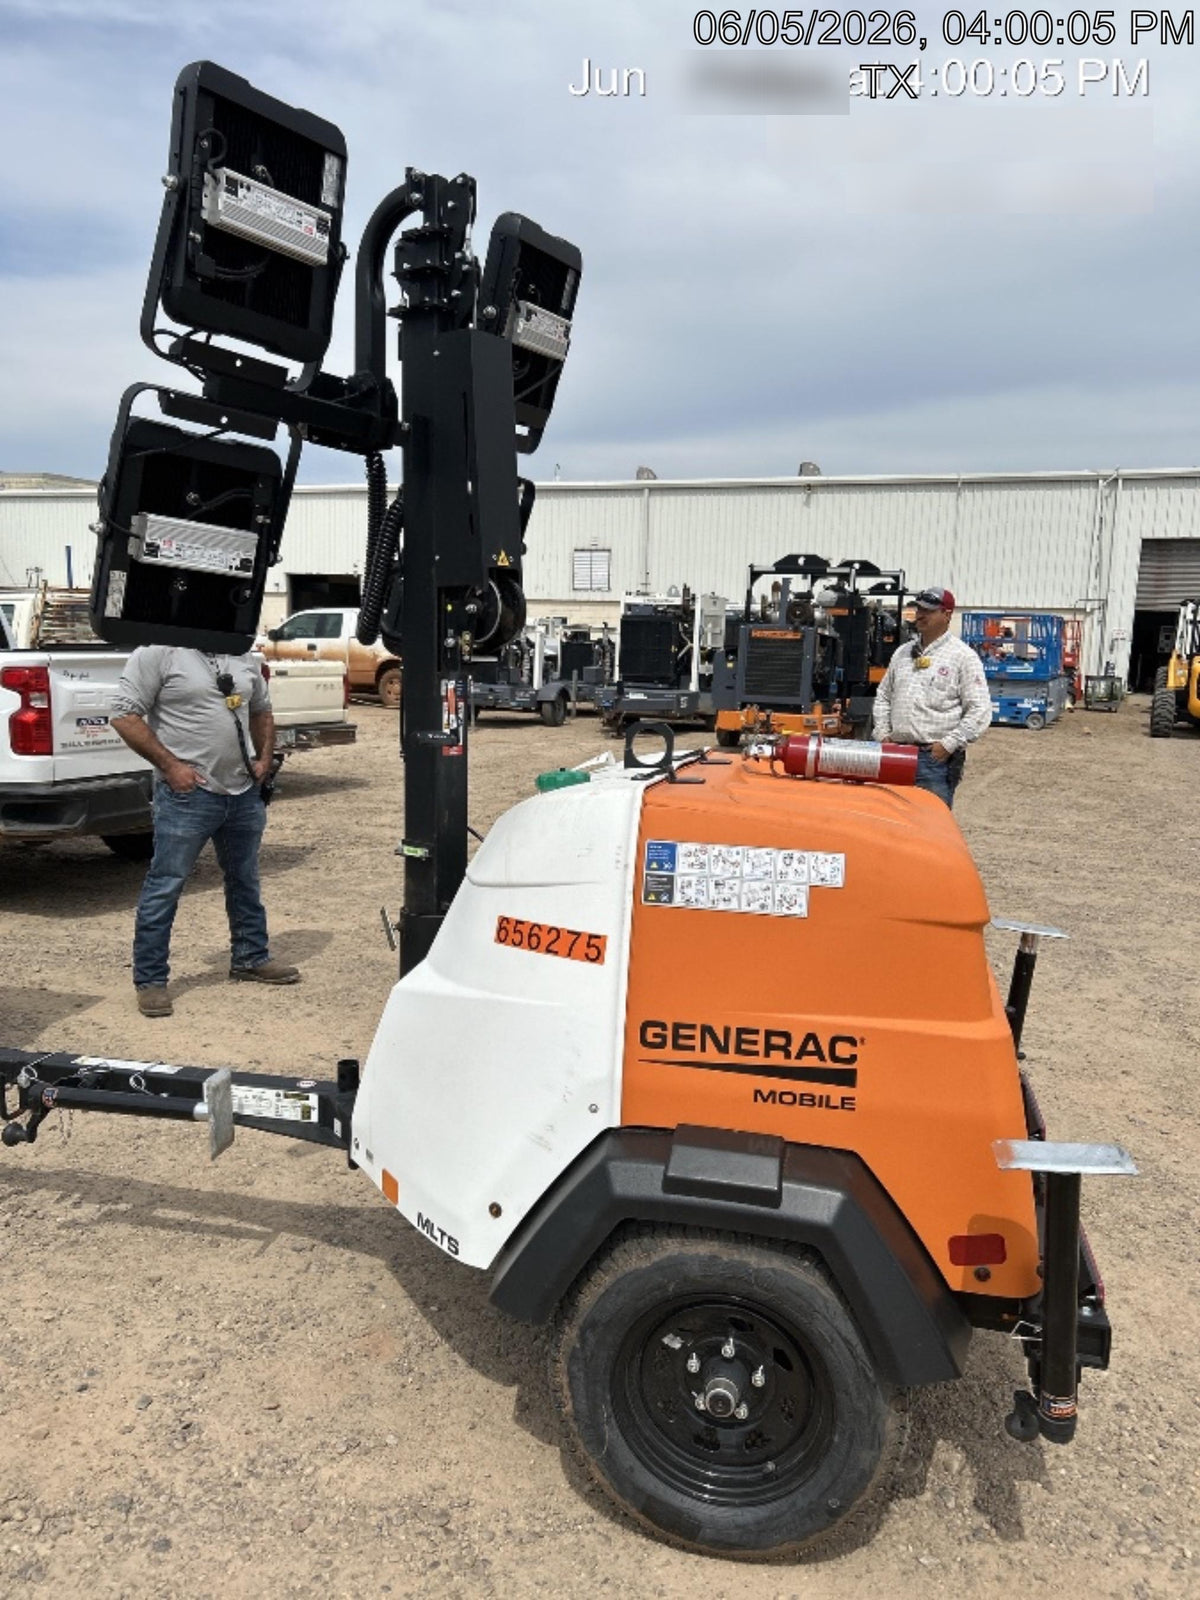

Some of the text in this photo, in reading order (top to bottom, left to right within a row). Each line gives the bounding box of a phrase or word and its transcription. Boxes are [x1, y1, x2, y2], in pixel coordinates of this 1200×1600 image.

[497, 917, 602, 962] 656275
[639, 1020, 859, 1065] GENERAC
[753, 1089, 857, 1111] MOBILE
[417, 1211, 460, 1256] MLTS
